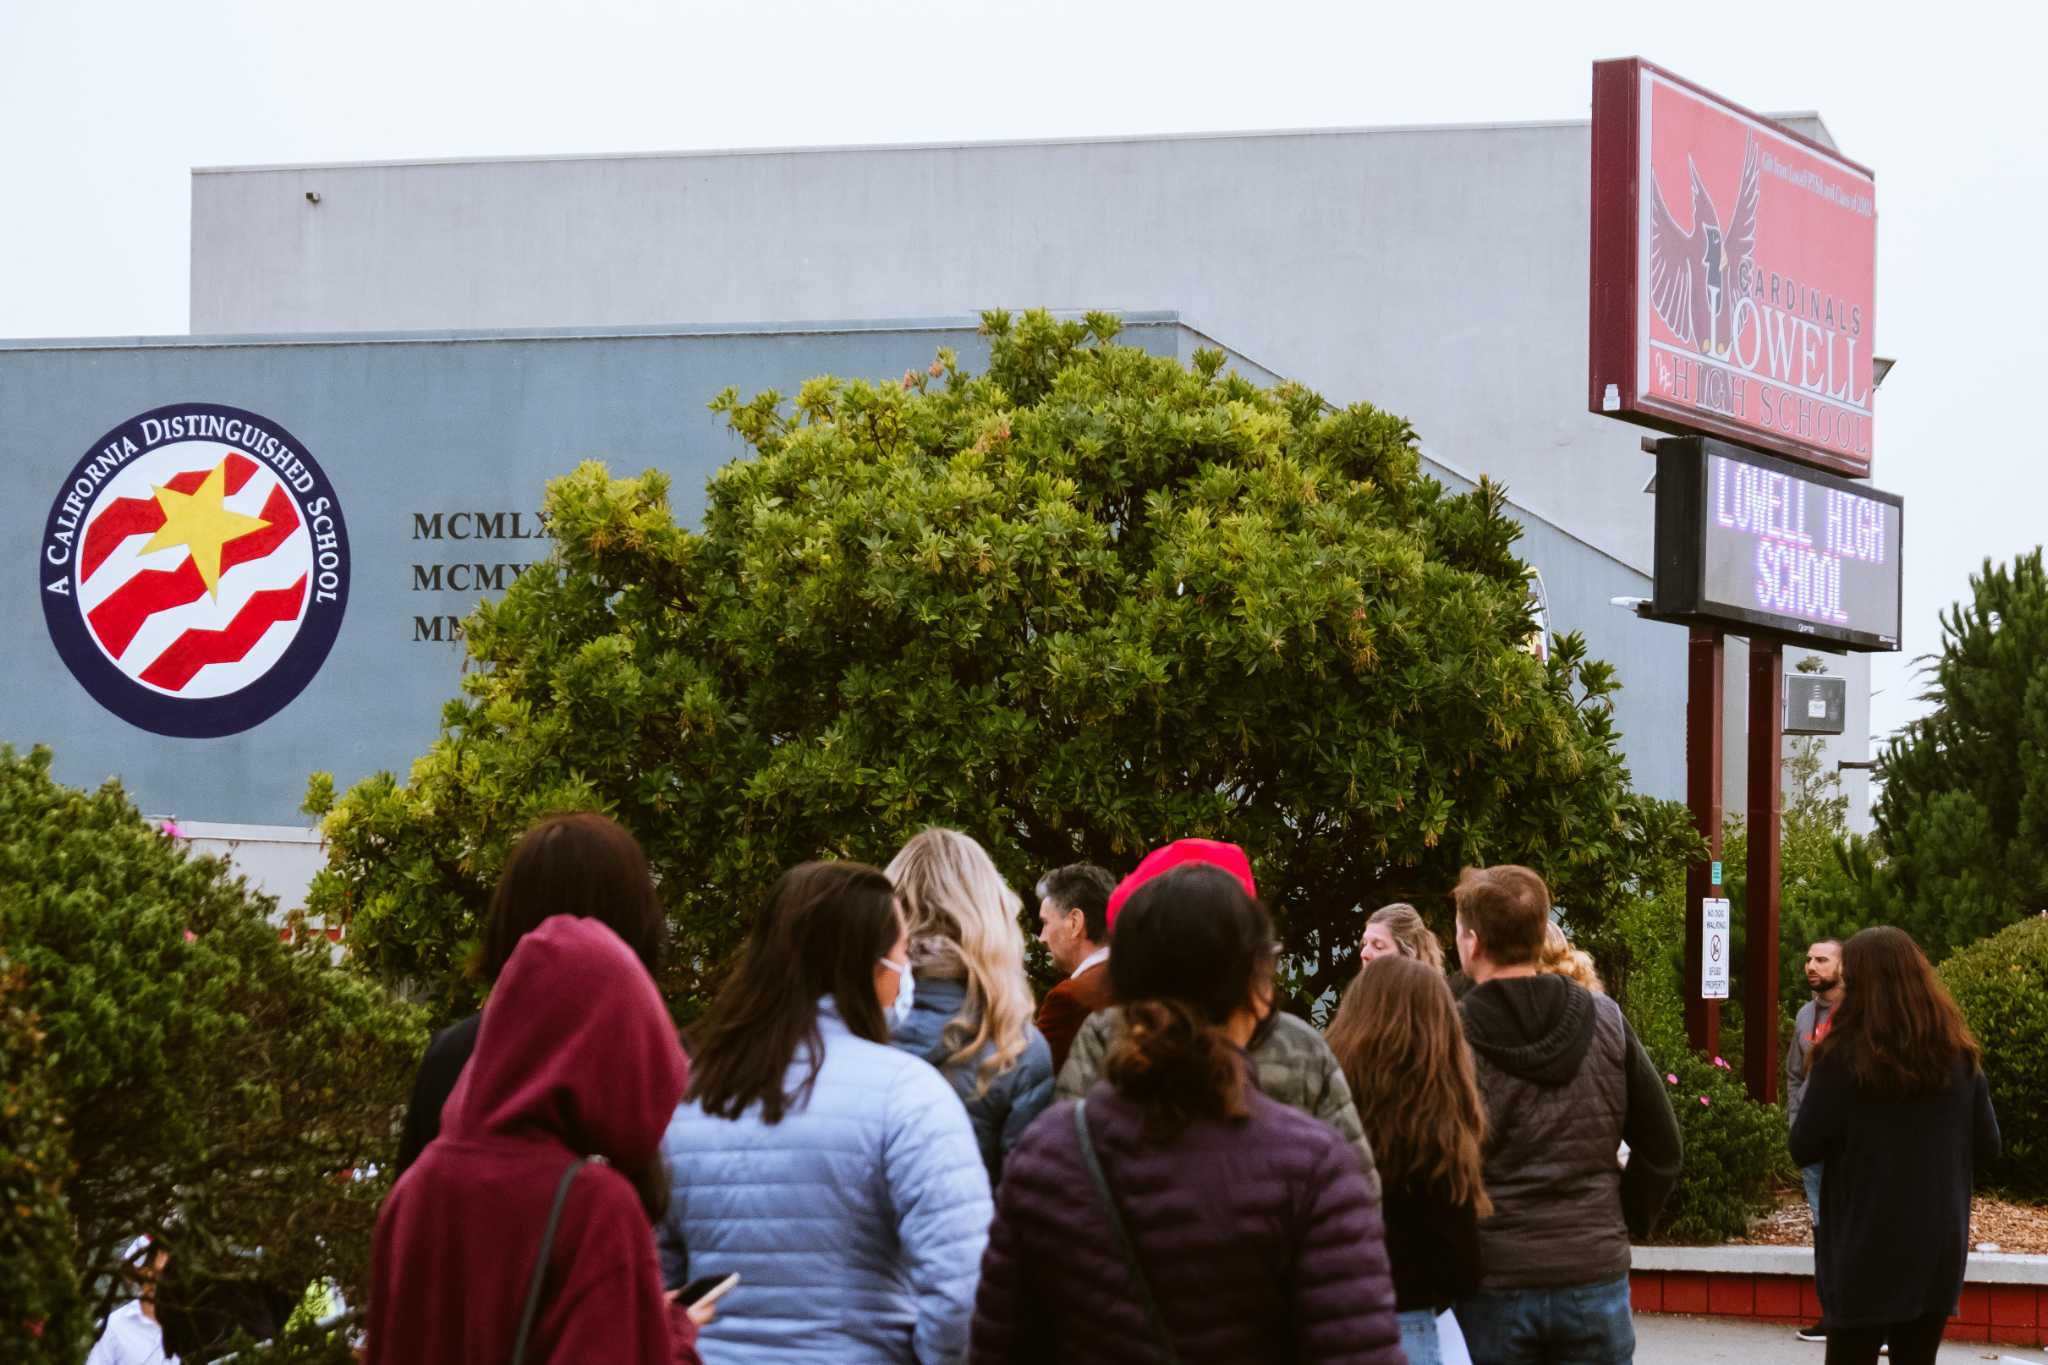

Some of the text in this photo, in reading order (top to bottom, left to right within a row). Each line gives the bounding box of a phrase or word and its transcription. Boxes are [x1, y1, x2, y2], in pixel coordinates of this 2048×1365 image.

[1707, 284, 1868, 408] LOWELL
[1739, 261, 1861, 336] CARDINALS
[1672, 356, 1749, 417] HIGH
[1760, 384, 1867, 454] SCHOOL
[46, 414, 339, 603] A CALIFORNIA DISTINGUISHED SCHOOL
[1716, 456, 1887, 564] LOWELL HIGH
[1755, 540, 1849, 623] SCHOOL
